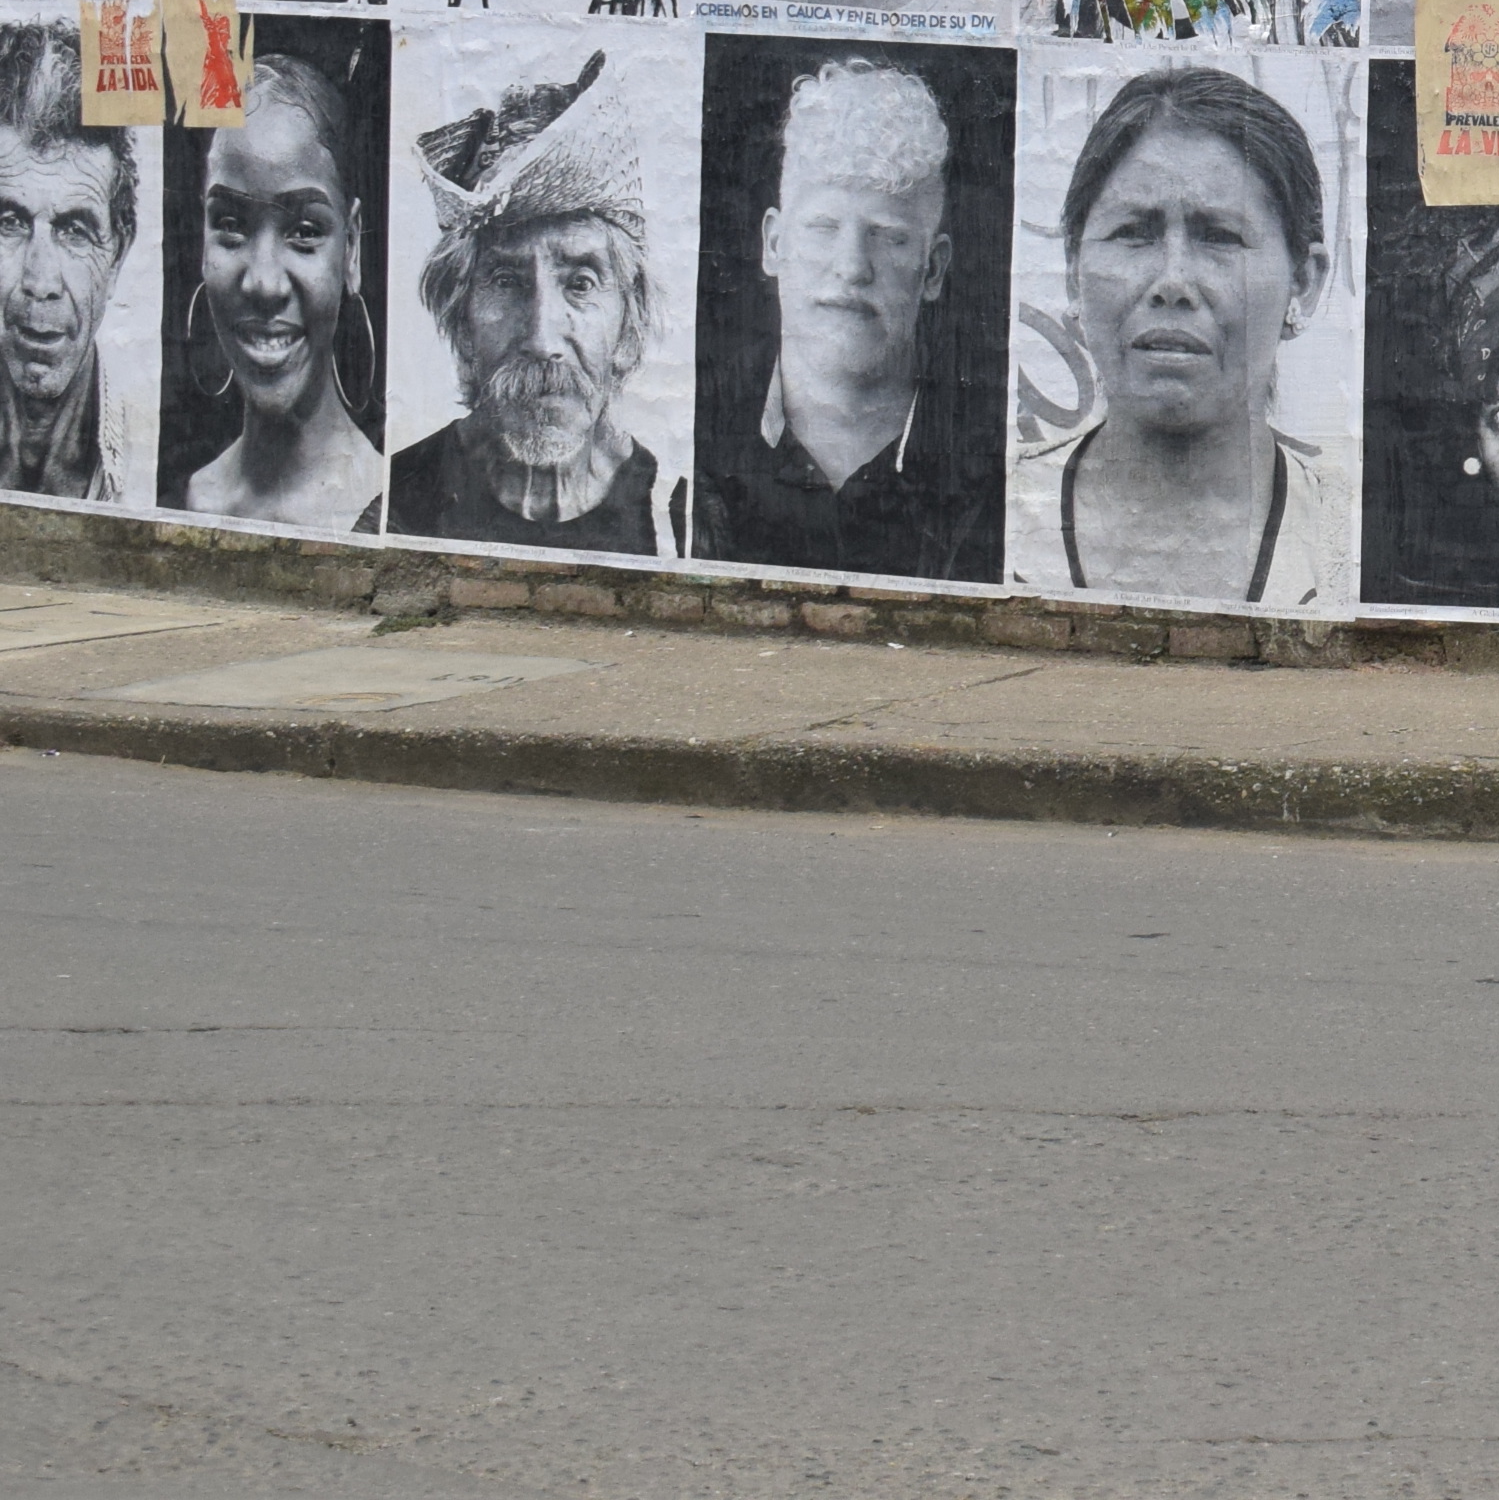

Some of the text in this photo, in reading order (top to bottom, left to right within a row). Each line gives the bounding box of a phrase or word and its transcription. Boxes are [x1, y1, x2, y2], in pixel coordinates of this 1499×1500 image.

[696, 3, 759, 18] ¡CREEMOS
[762, 6, 777, 19] EN
[786, 4, 833, 20] CAUCA
[836, 8, 845, 21] Y
[847, 10, 863, 23] EN
[865, 12, 879, 26] EL
[881, 12, 926, 28] PODER
[929, 14, 946, 28] DE
[949, 15, 966, 29] SU
[96, 68, 117, 92] LA
[1436, 130, 1472, 155] LA
